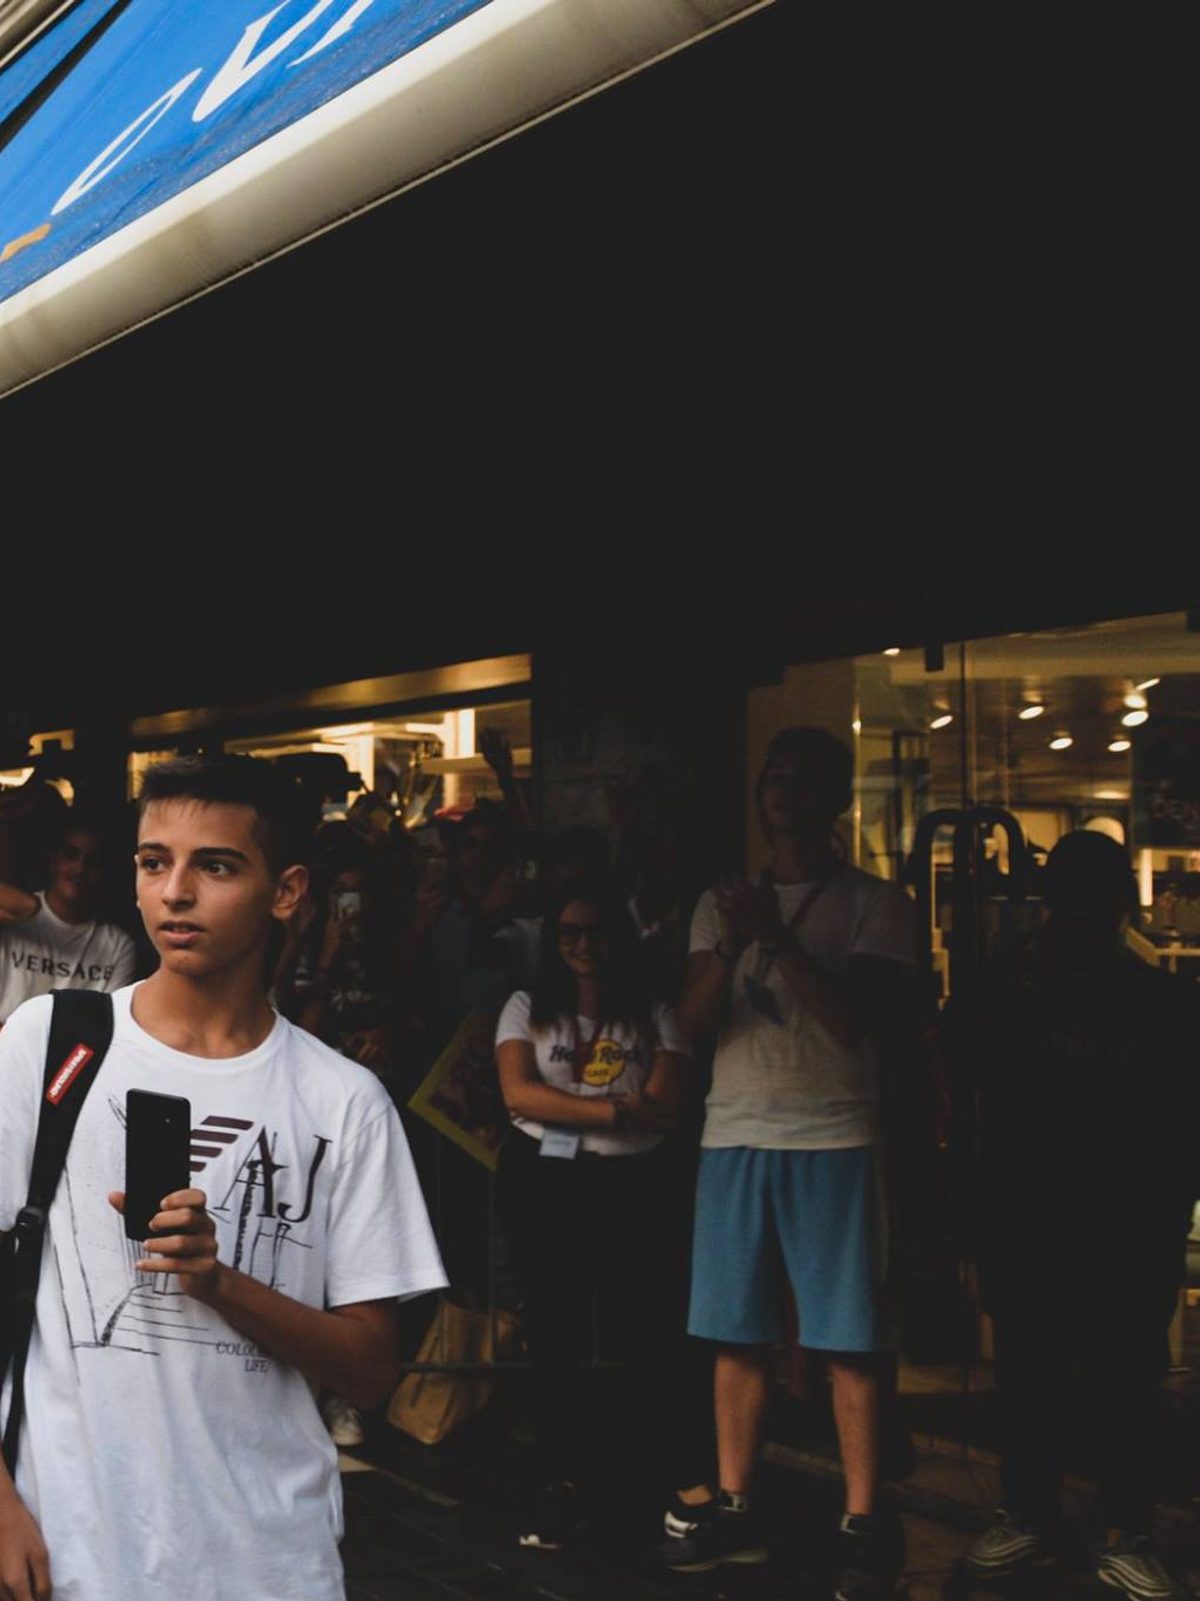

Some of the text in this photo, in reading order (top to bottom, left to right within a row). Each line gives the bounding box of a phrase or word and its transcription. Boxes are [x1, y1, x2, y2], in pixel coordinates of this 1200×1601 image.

[11, 951, 115, 982] VERSACE
[213, 1125, 334, 1223] AJ
[245, 1358, 269, 1373] LIFE
